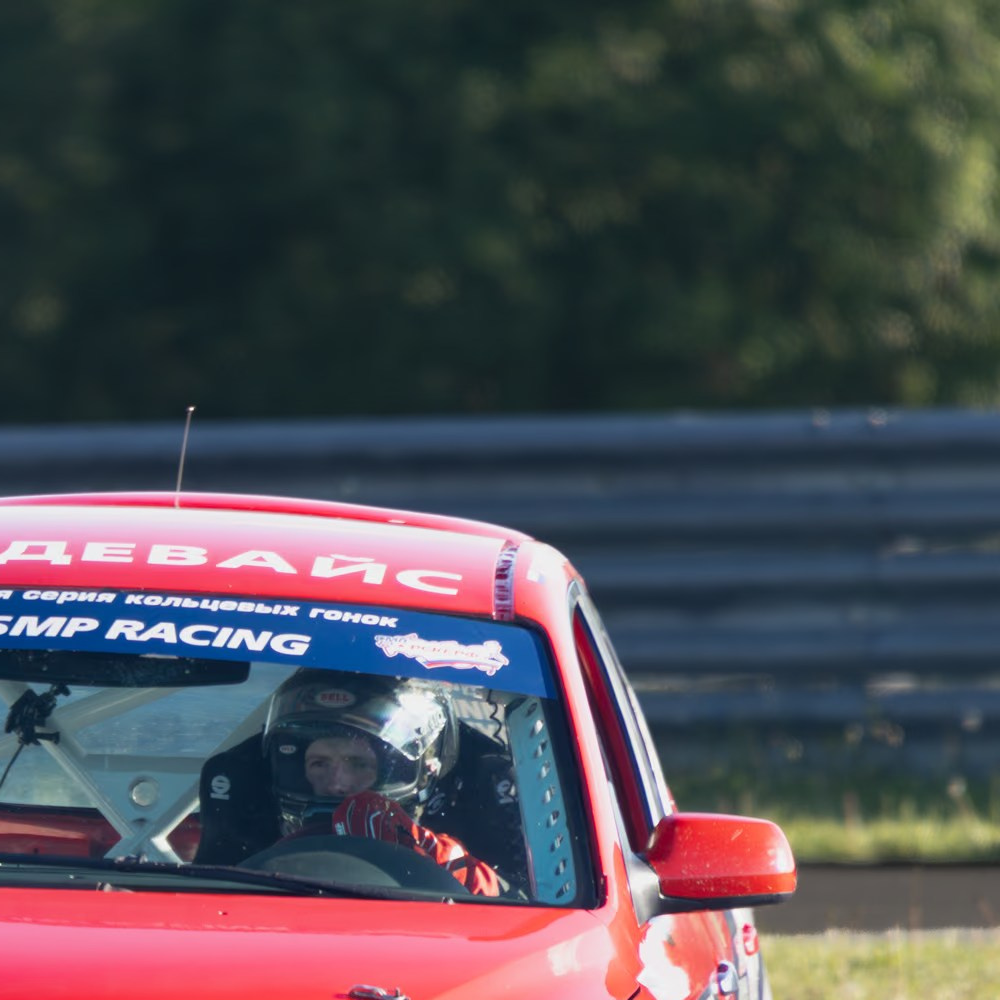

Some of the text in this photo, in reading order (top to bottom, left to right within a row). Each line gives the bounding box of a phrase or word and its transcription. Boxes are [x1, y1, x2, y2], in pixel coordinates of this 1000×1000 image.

[22, 589, 116, 605] серия
[124, 593, 300, 616] кольцевых
[309, 607, 399, 629] гонок
[104, 618, 312, 656] RACING
